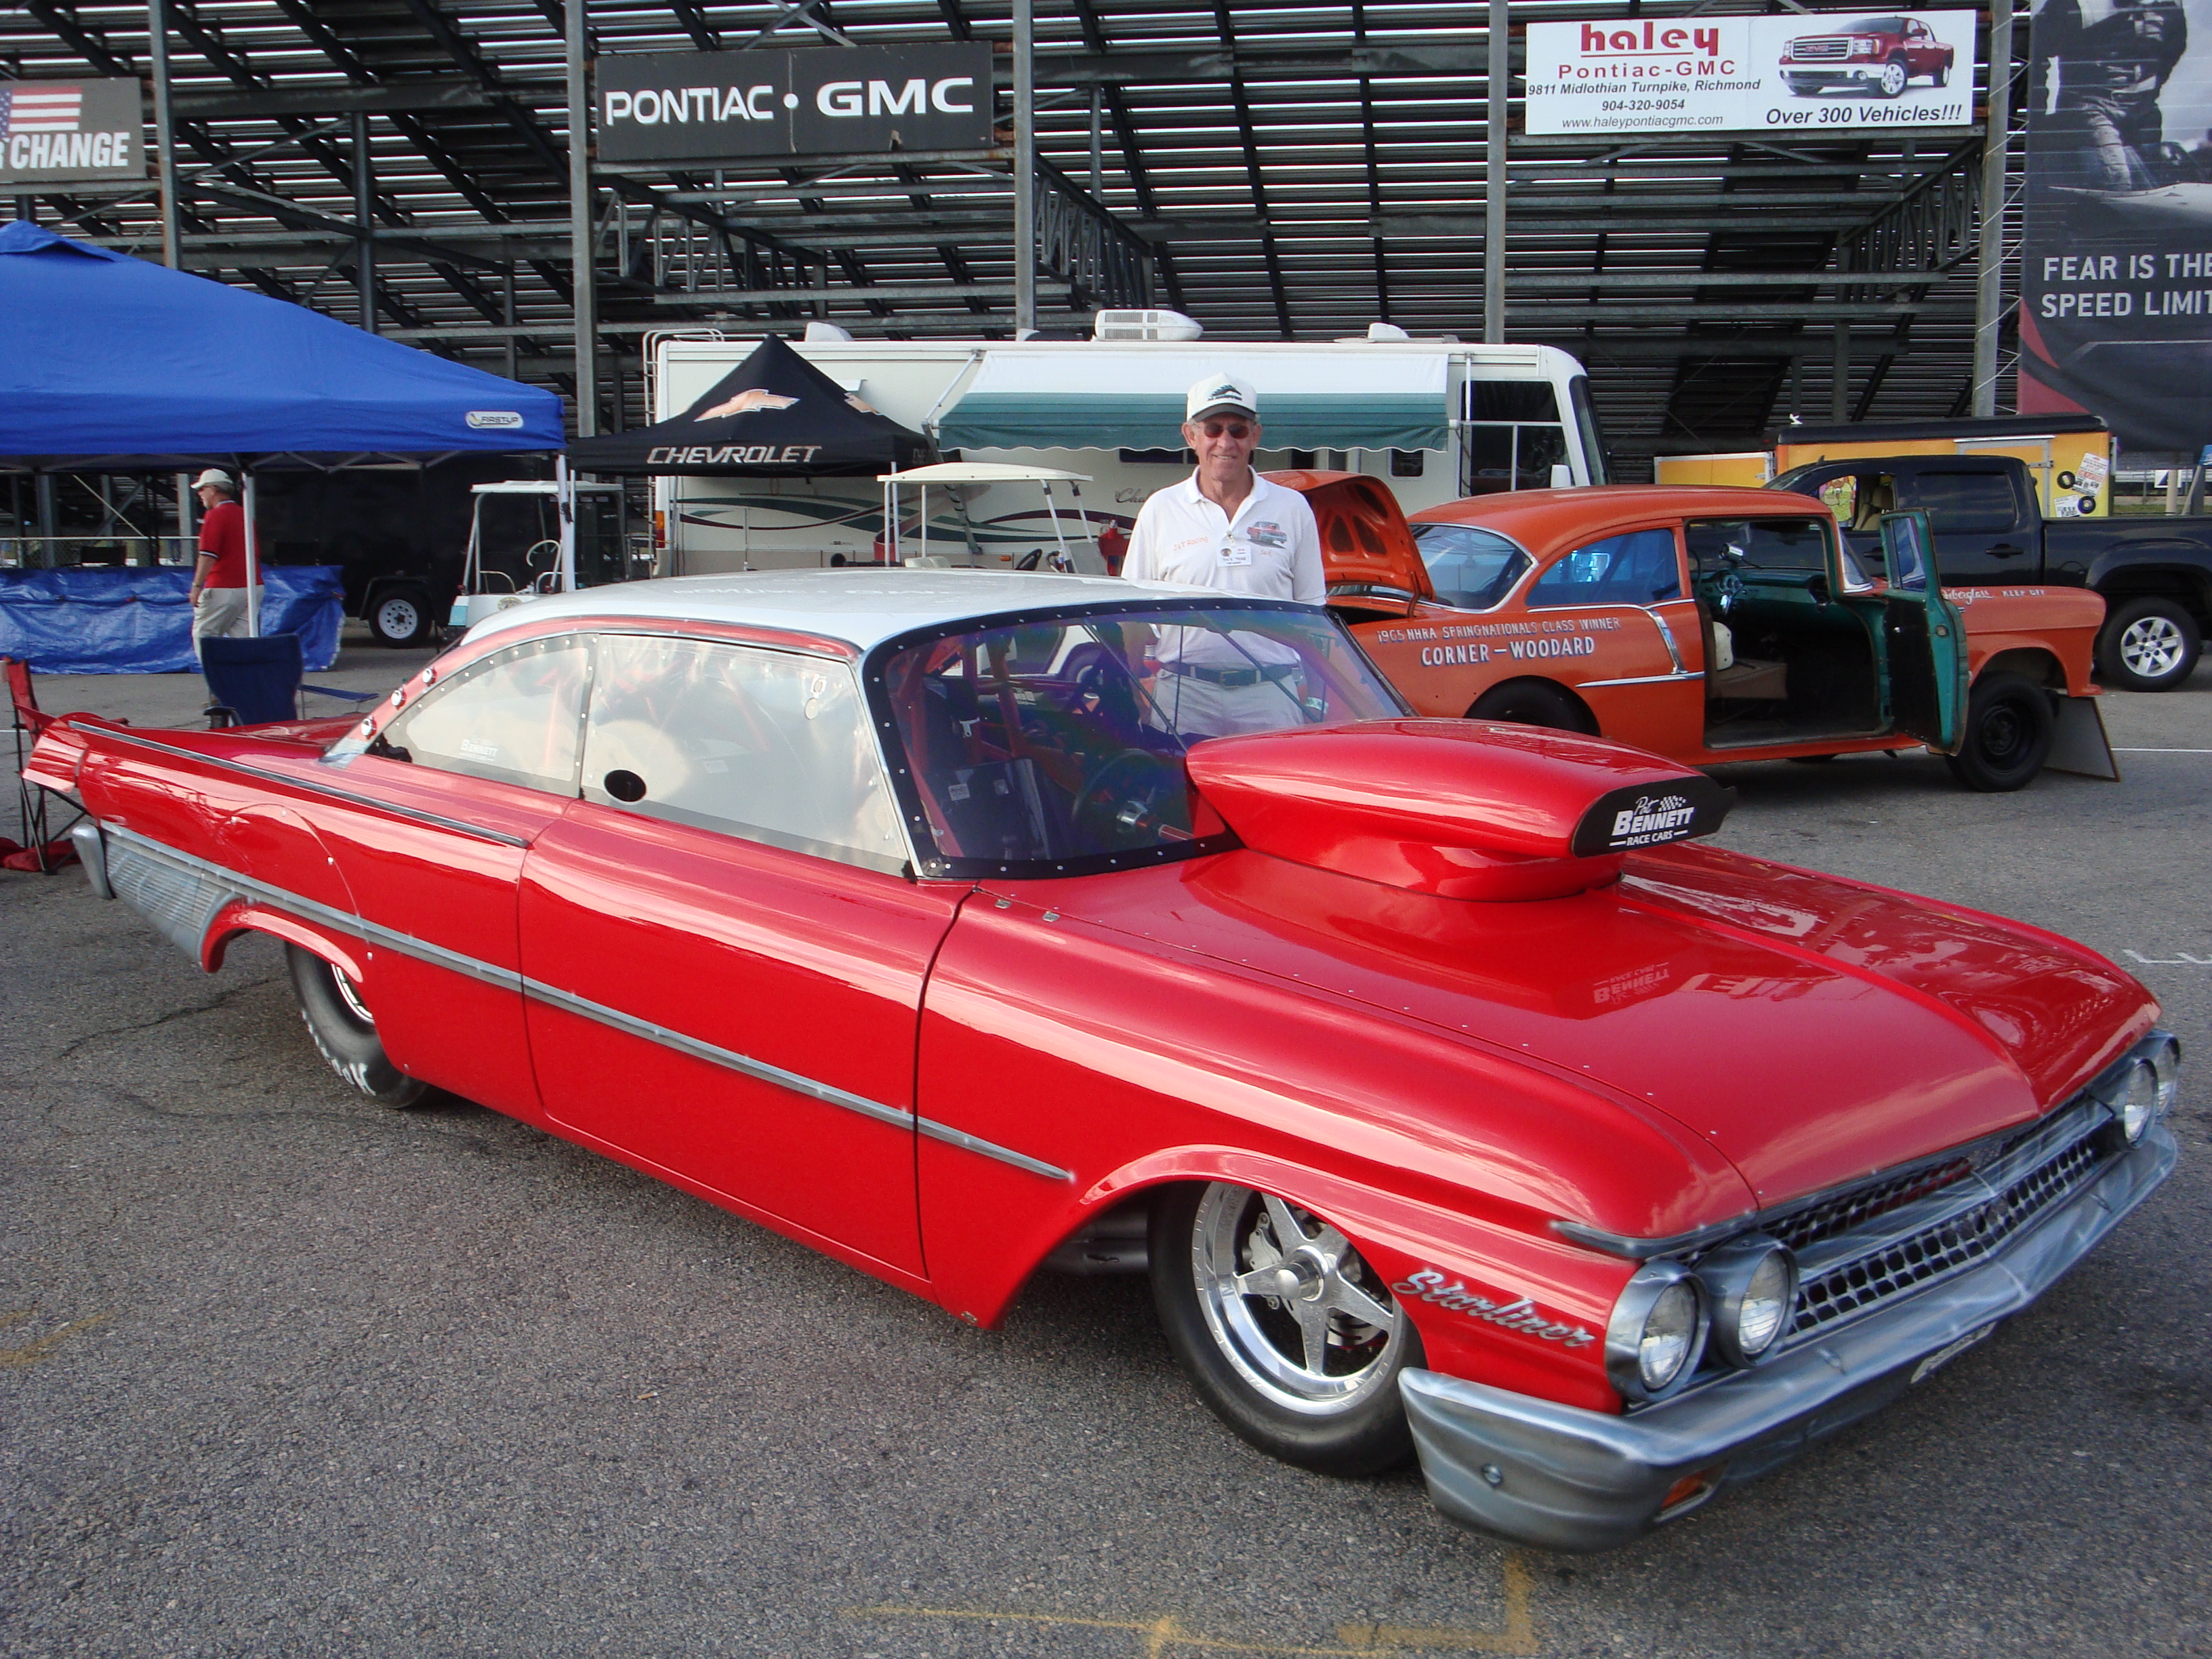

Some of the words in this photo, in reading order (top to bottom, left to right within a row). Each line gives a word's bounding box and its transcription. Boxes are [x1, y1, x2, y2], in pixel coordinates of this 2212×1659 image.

[1580, 22, 1719, 56] haley
[1559, 60, 1736, 79] Pontiac-GMC
[1528, 85, 1556, 96] 9811
[1560, 83, 1626, 95] Midlothian
[1632, 81, 1690, 95] Turnpike,
[1694, 79, 1761, 91] Richmond
[605, 85, 774, 126] PONTIAC
[817, 77, 973, 117] GMC
[1601, 100, 1685, 111] 904-320-9054
[1766, 108, 1813, 124] Over
[1818, 107, 1852, 123] 300
[1860, 104, 1962, 122] Vehicles!!!
[1562, 115, 1723, 128] www.haleypontiacgmc.com
[9, 131, 131, 169] CHANGE
[2043, 255, 2117, 281] FEAR
[2129, 254, 2154, 279] IS
[2041, 292, 2132, 318] SPEED
[647, 445, 822, 465] CHEVROLET
[1407, 628, 1437, 642] NHRA
[1441, 621, 1538, 640] SPRINGNATIONALS
[1542, 619, 1576, 634] CLASS
[1579, 617, 1621, 631] WINNER
[1421, 643, 1490, 666] CORNER
[1510, 636, 1595, 660] WOODARD
[1611, 806, 1694, 836] BENNETT
[1626, 834, 1650, 846] RACE
[1652, 830, 1674, 842] CARS
[1391, 1268, 1595, 1348] Starliner
